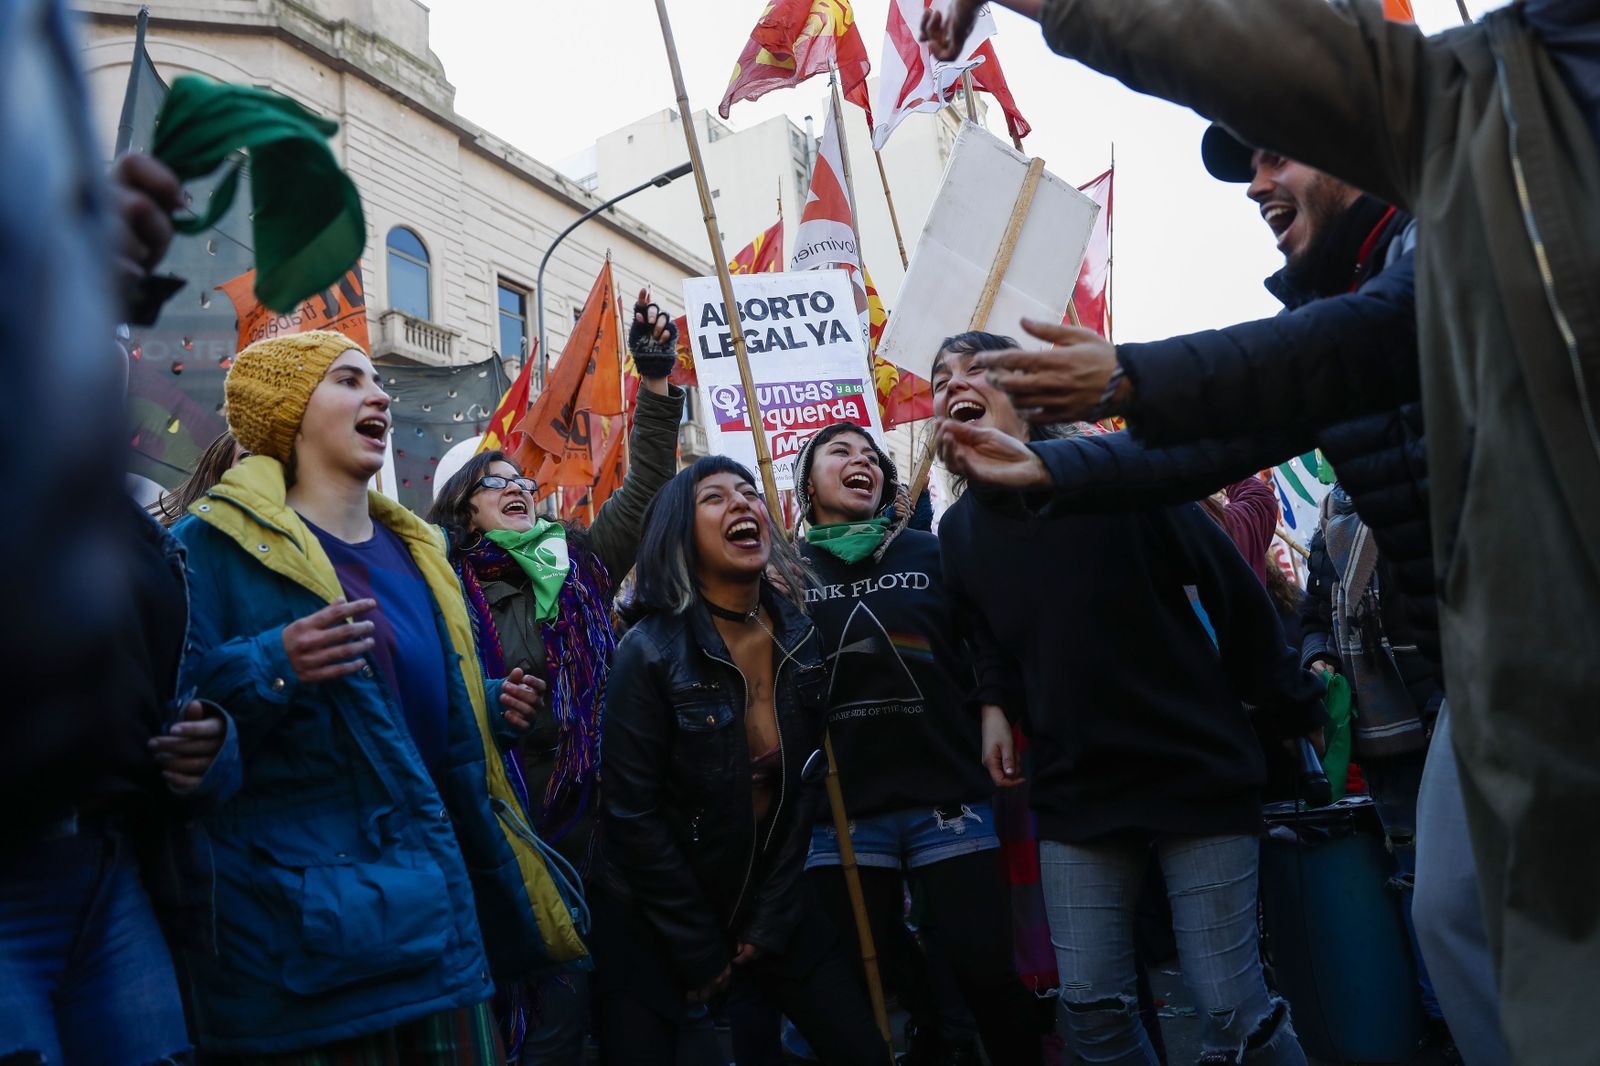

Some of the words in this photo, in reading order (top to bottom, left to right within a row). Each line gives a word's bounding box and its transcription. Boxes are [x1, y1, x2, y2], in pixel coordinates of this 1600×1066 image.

[698, 326, 808, 360] LEGAL
[805, 319, 853, 347] YA
[743, 381, 834, 407] untas
[803, 584, 846, 603] INK
[850, 571, 930, 598] FLOYD
